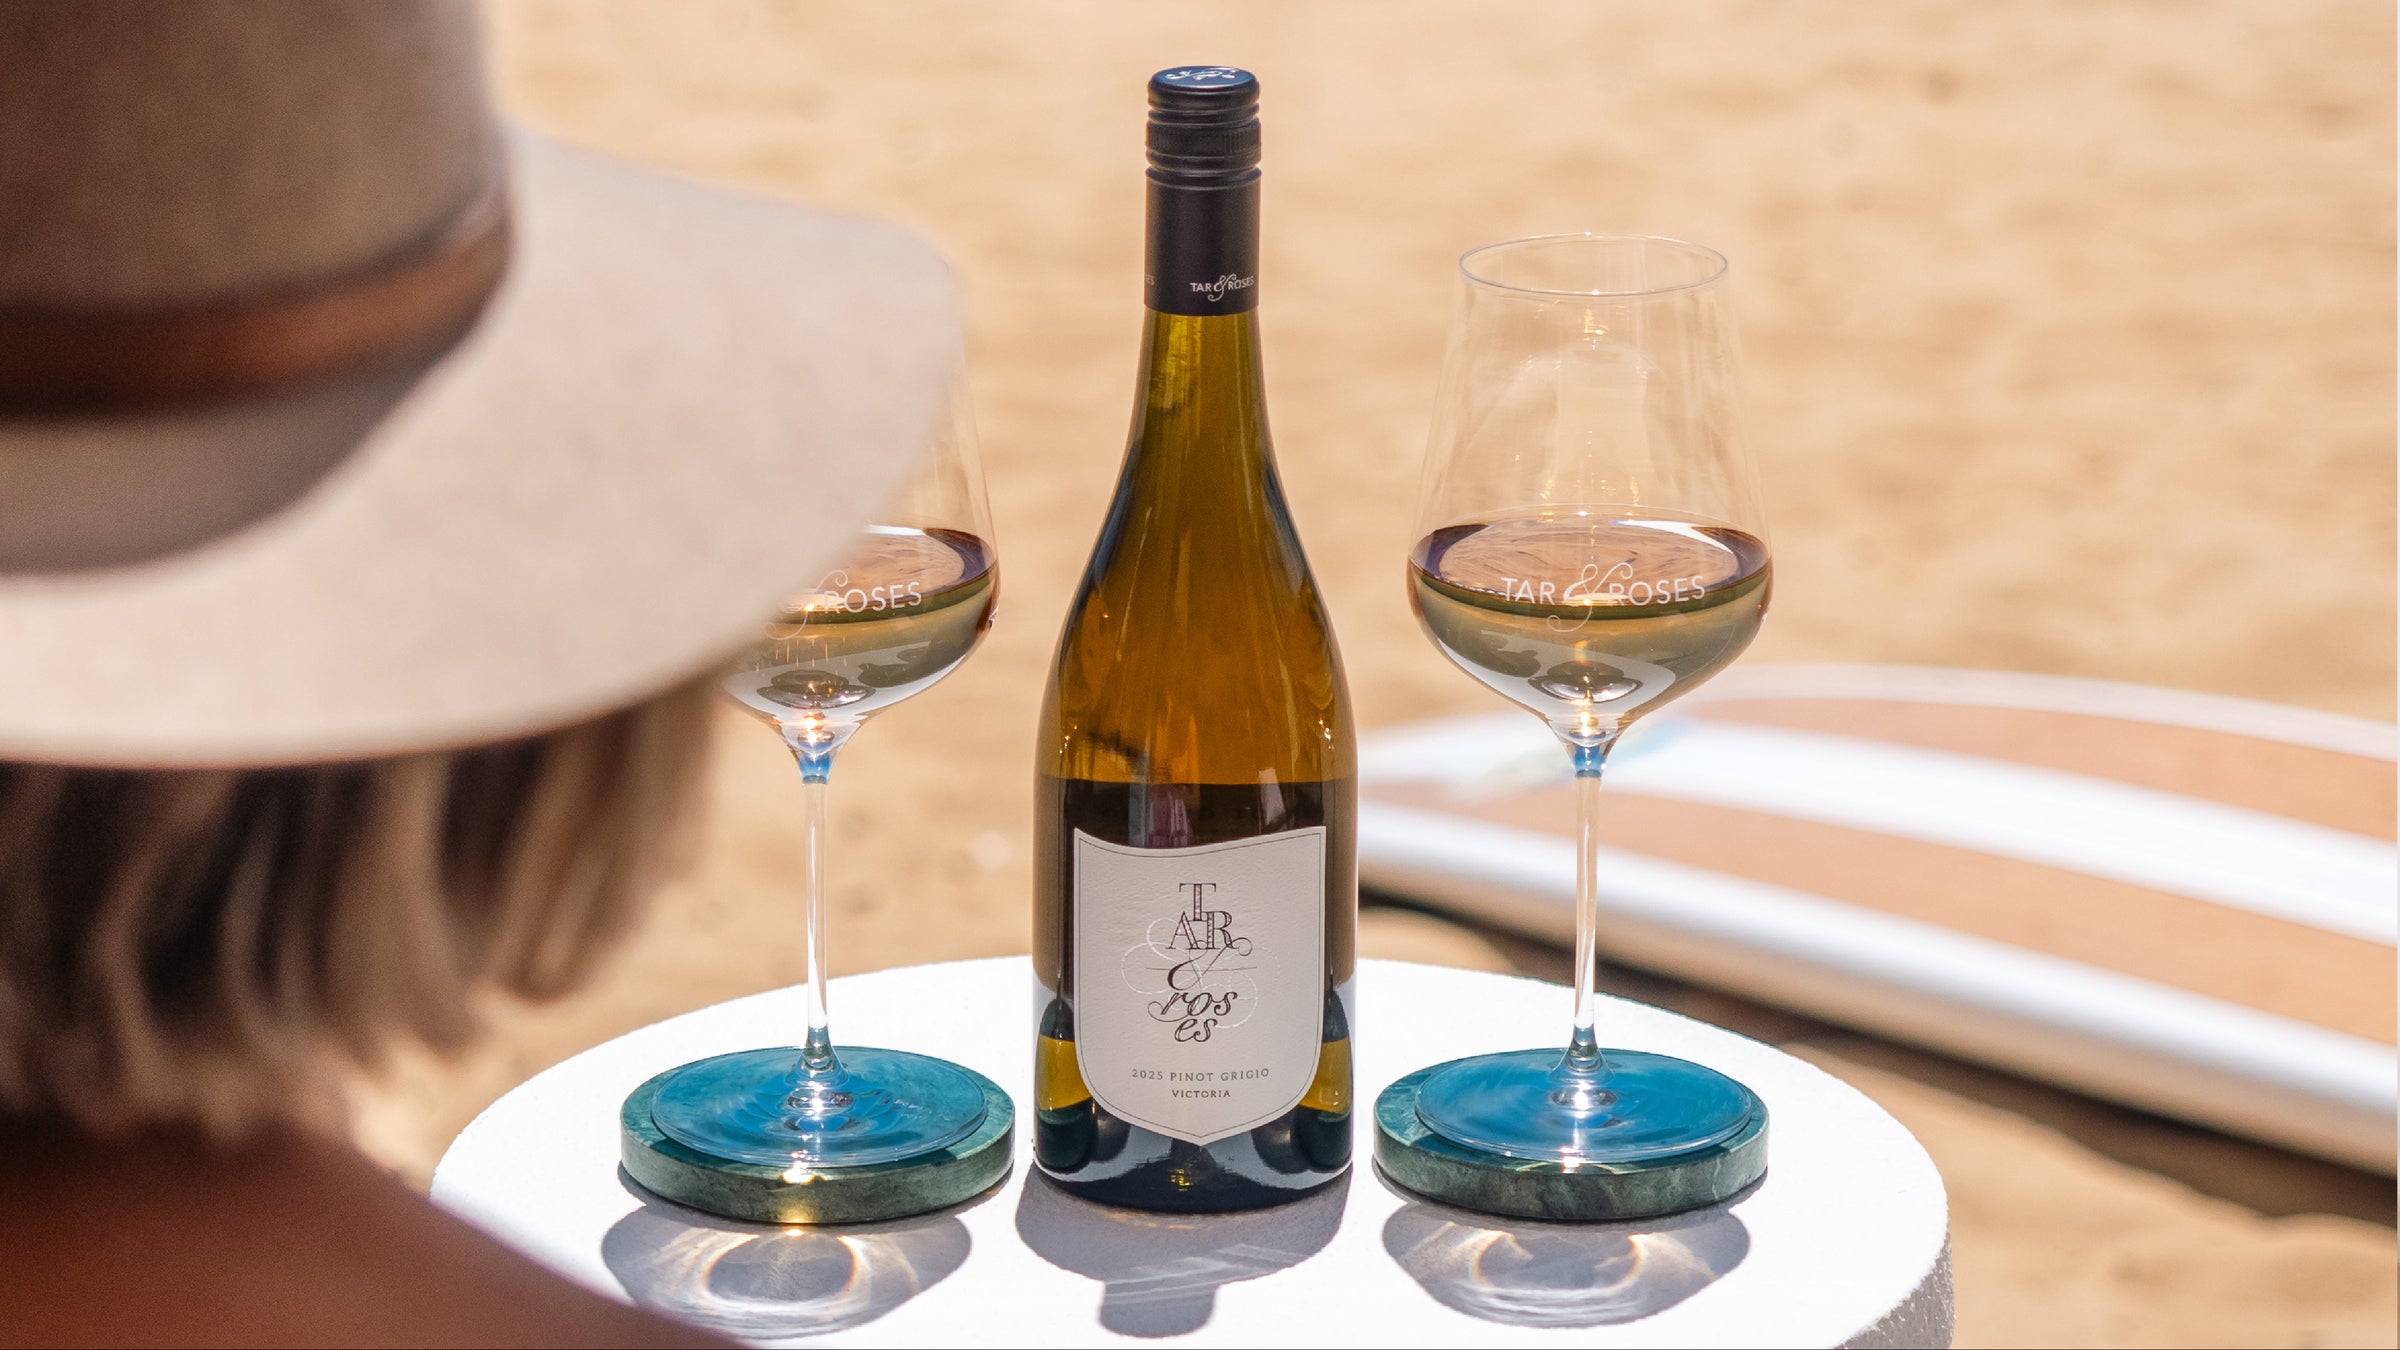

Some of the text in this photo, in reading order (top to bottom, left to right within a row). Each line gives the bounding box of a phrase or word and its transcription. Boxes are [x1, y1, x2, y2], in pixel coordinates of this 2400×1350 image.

[1189, 282, 1212, 292] TAR
[1227, 275, 1255, 291] ROSES
[823, 581, 922, 614] ROSES
[1501, 576, 1556, 606] TAR
[1609, 575, 1706, 607] ROSES
[1131, 1067, 1271, 1082] 2025 PINOT GRIGIO
[1171, 1089, 1232, 1099] VICTORIA
